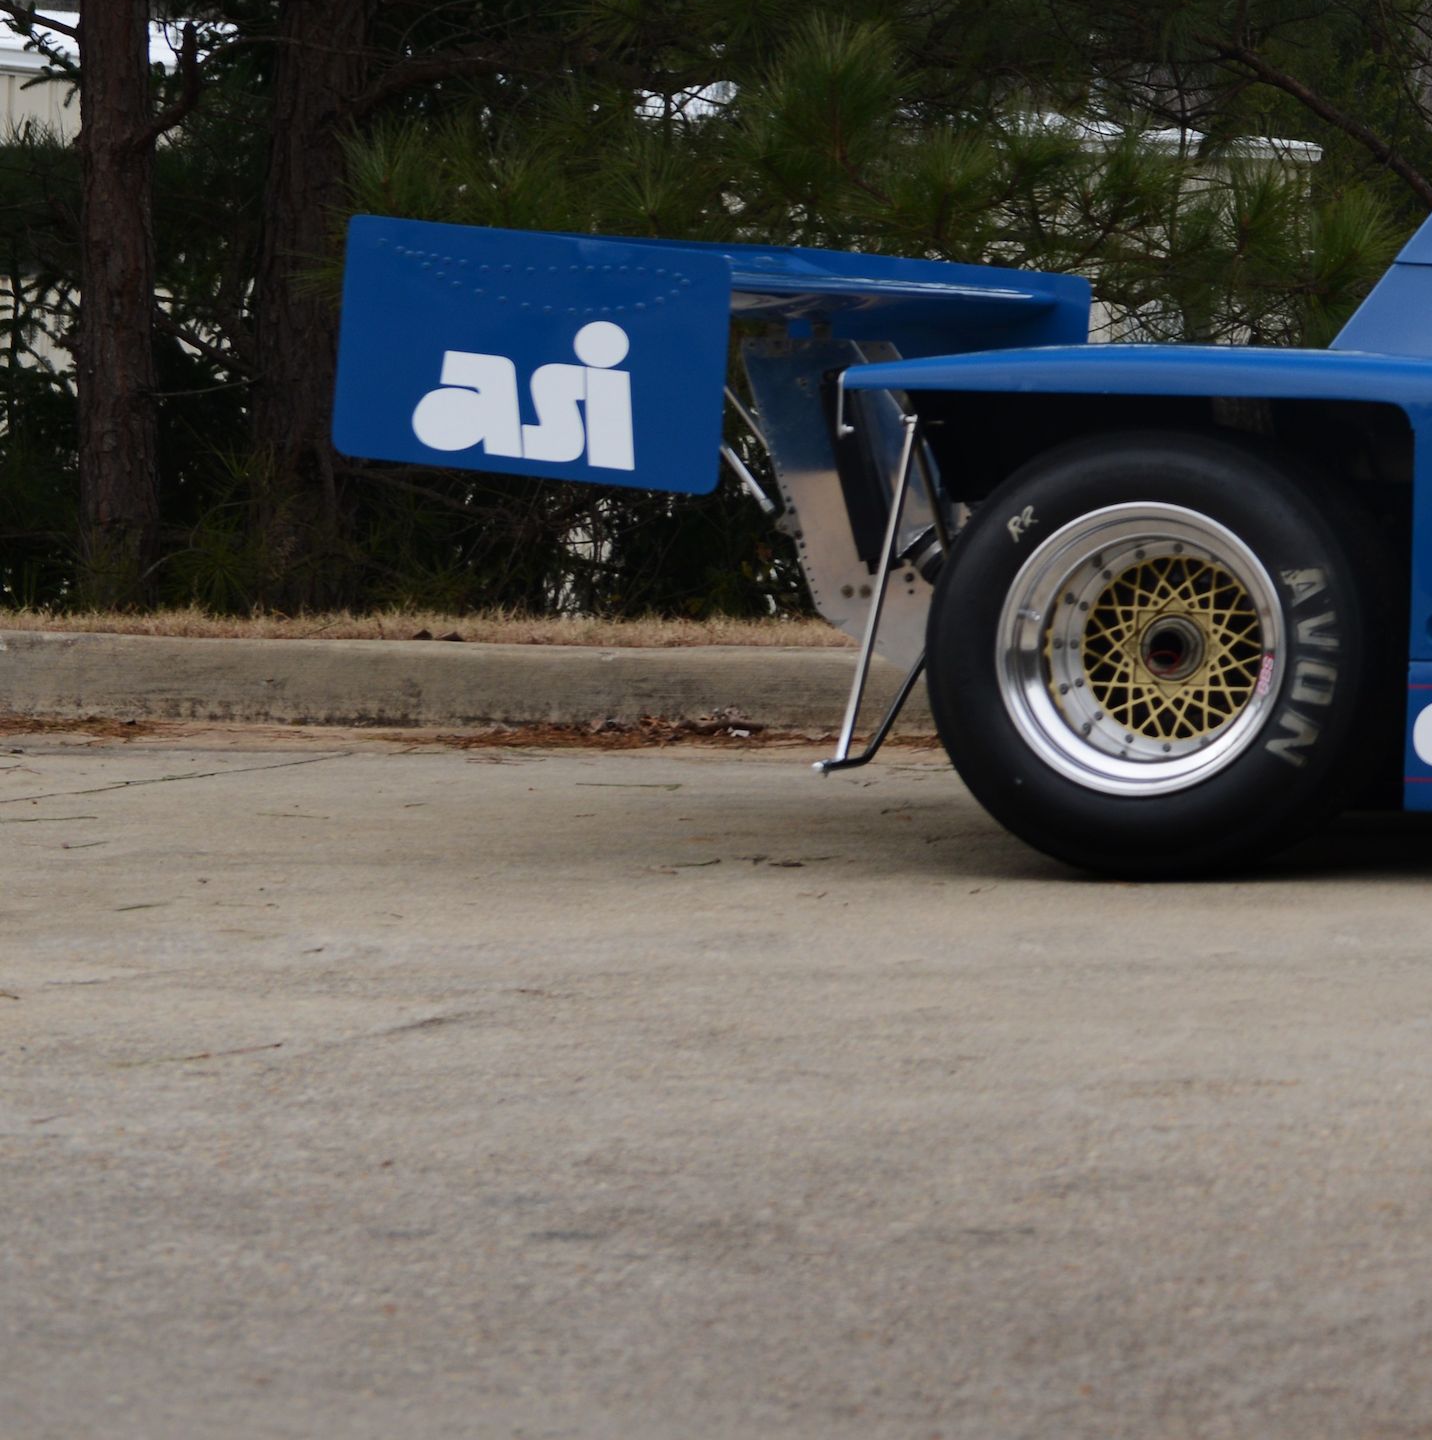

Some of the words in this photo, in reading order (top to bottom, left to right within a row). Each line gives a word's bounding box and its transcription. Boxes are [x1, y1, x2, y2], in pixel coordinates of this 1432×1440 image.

[410, 320, 636, 471] asi
[1007, 504, 1039, 543] RR
[1264, 566, 1342, 769] AVON
